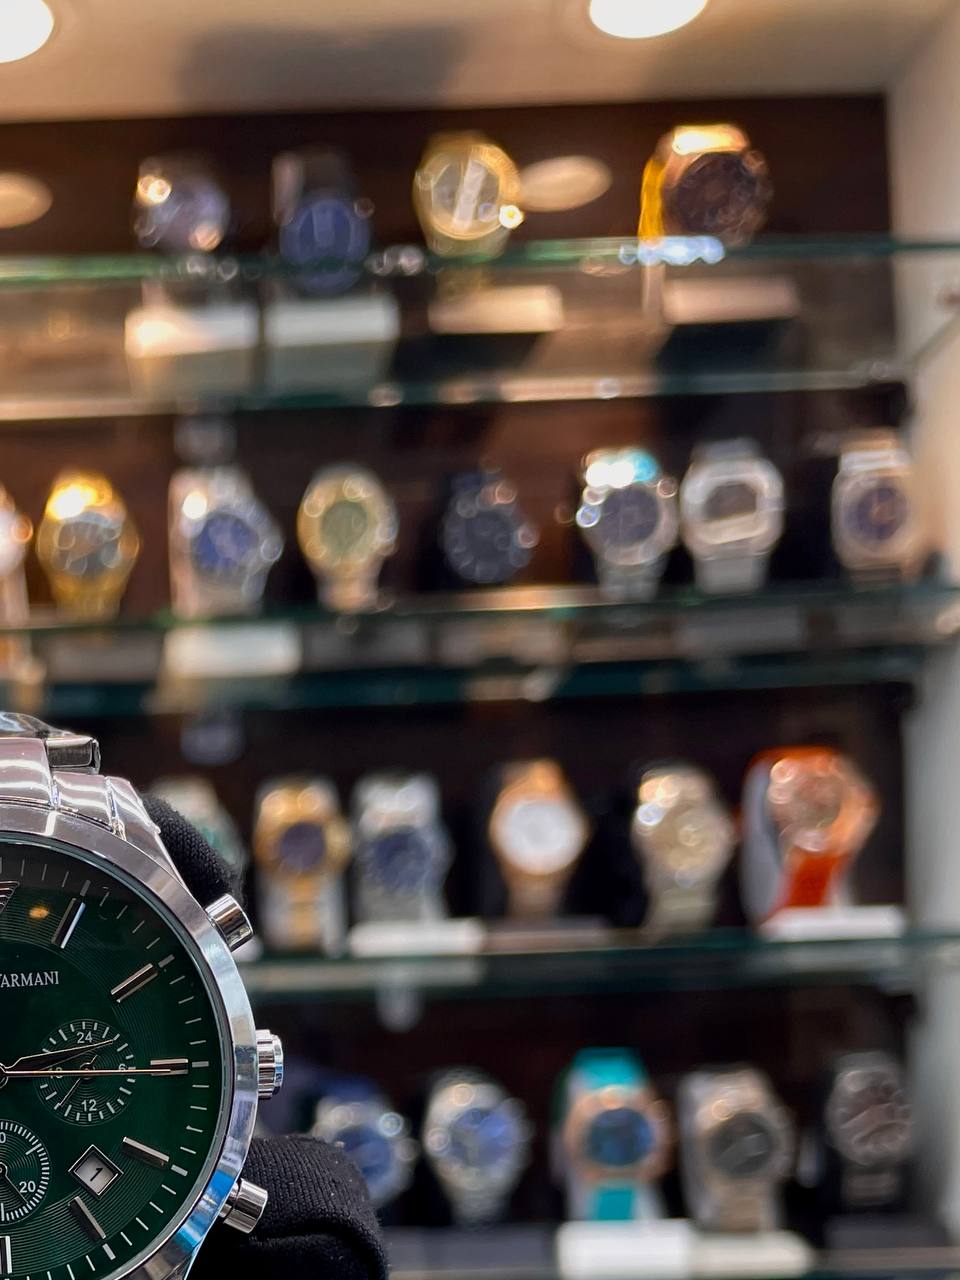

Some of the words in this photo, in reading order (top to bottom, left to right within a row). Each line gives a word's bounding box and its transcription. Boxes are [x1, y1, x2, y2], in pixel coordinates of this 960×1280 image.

[0, 971, 60, 988] ARMANI
[76, 1031, 93, 1044] 24
[81, 1099, 97, 1112] 12
[19, 1181, 36, 1193] 20
